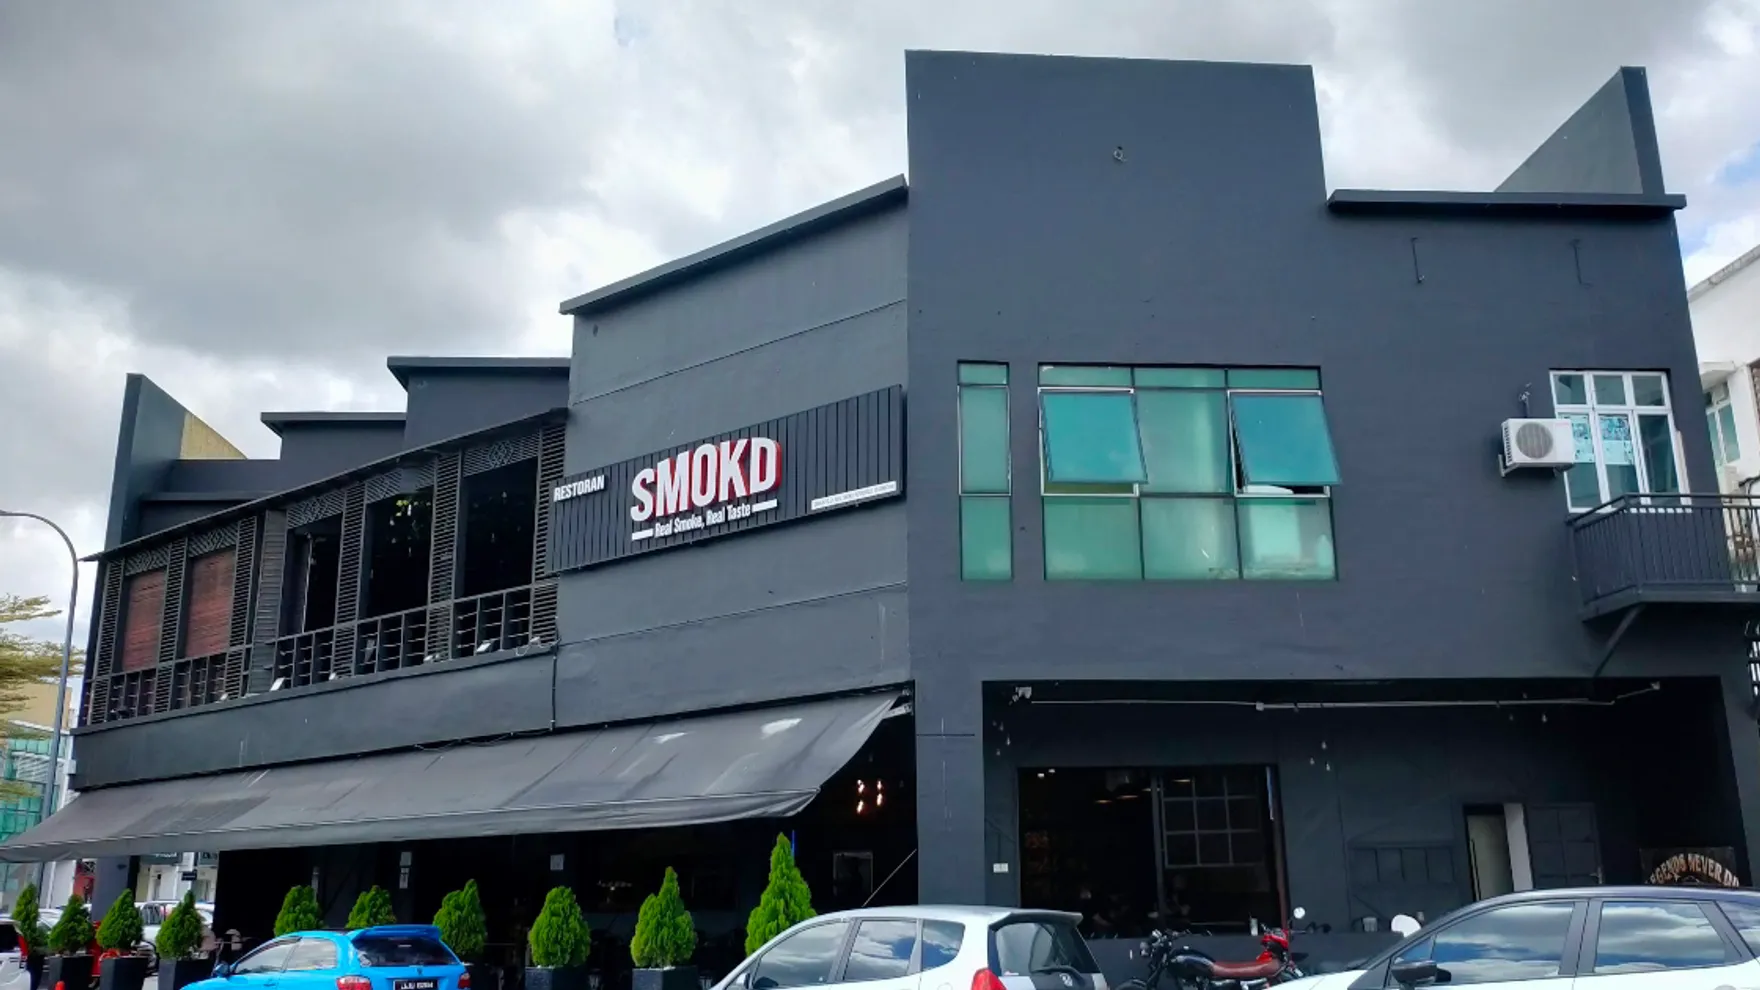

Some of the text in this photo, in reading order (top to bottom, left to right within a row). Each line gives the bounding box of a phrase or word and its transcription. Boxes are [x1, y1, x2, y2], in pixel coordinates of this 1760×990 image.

[553, 474, 605, 502] RESTORAN
[630, 436, 781, 523] SMOKD
[654, 503, 751, 538] Real Smoke, Real Taste
[1687, 853, 1722, 883] NEVER
